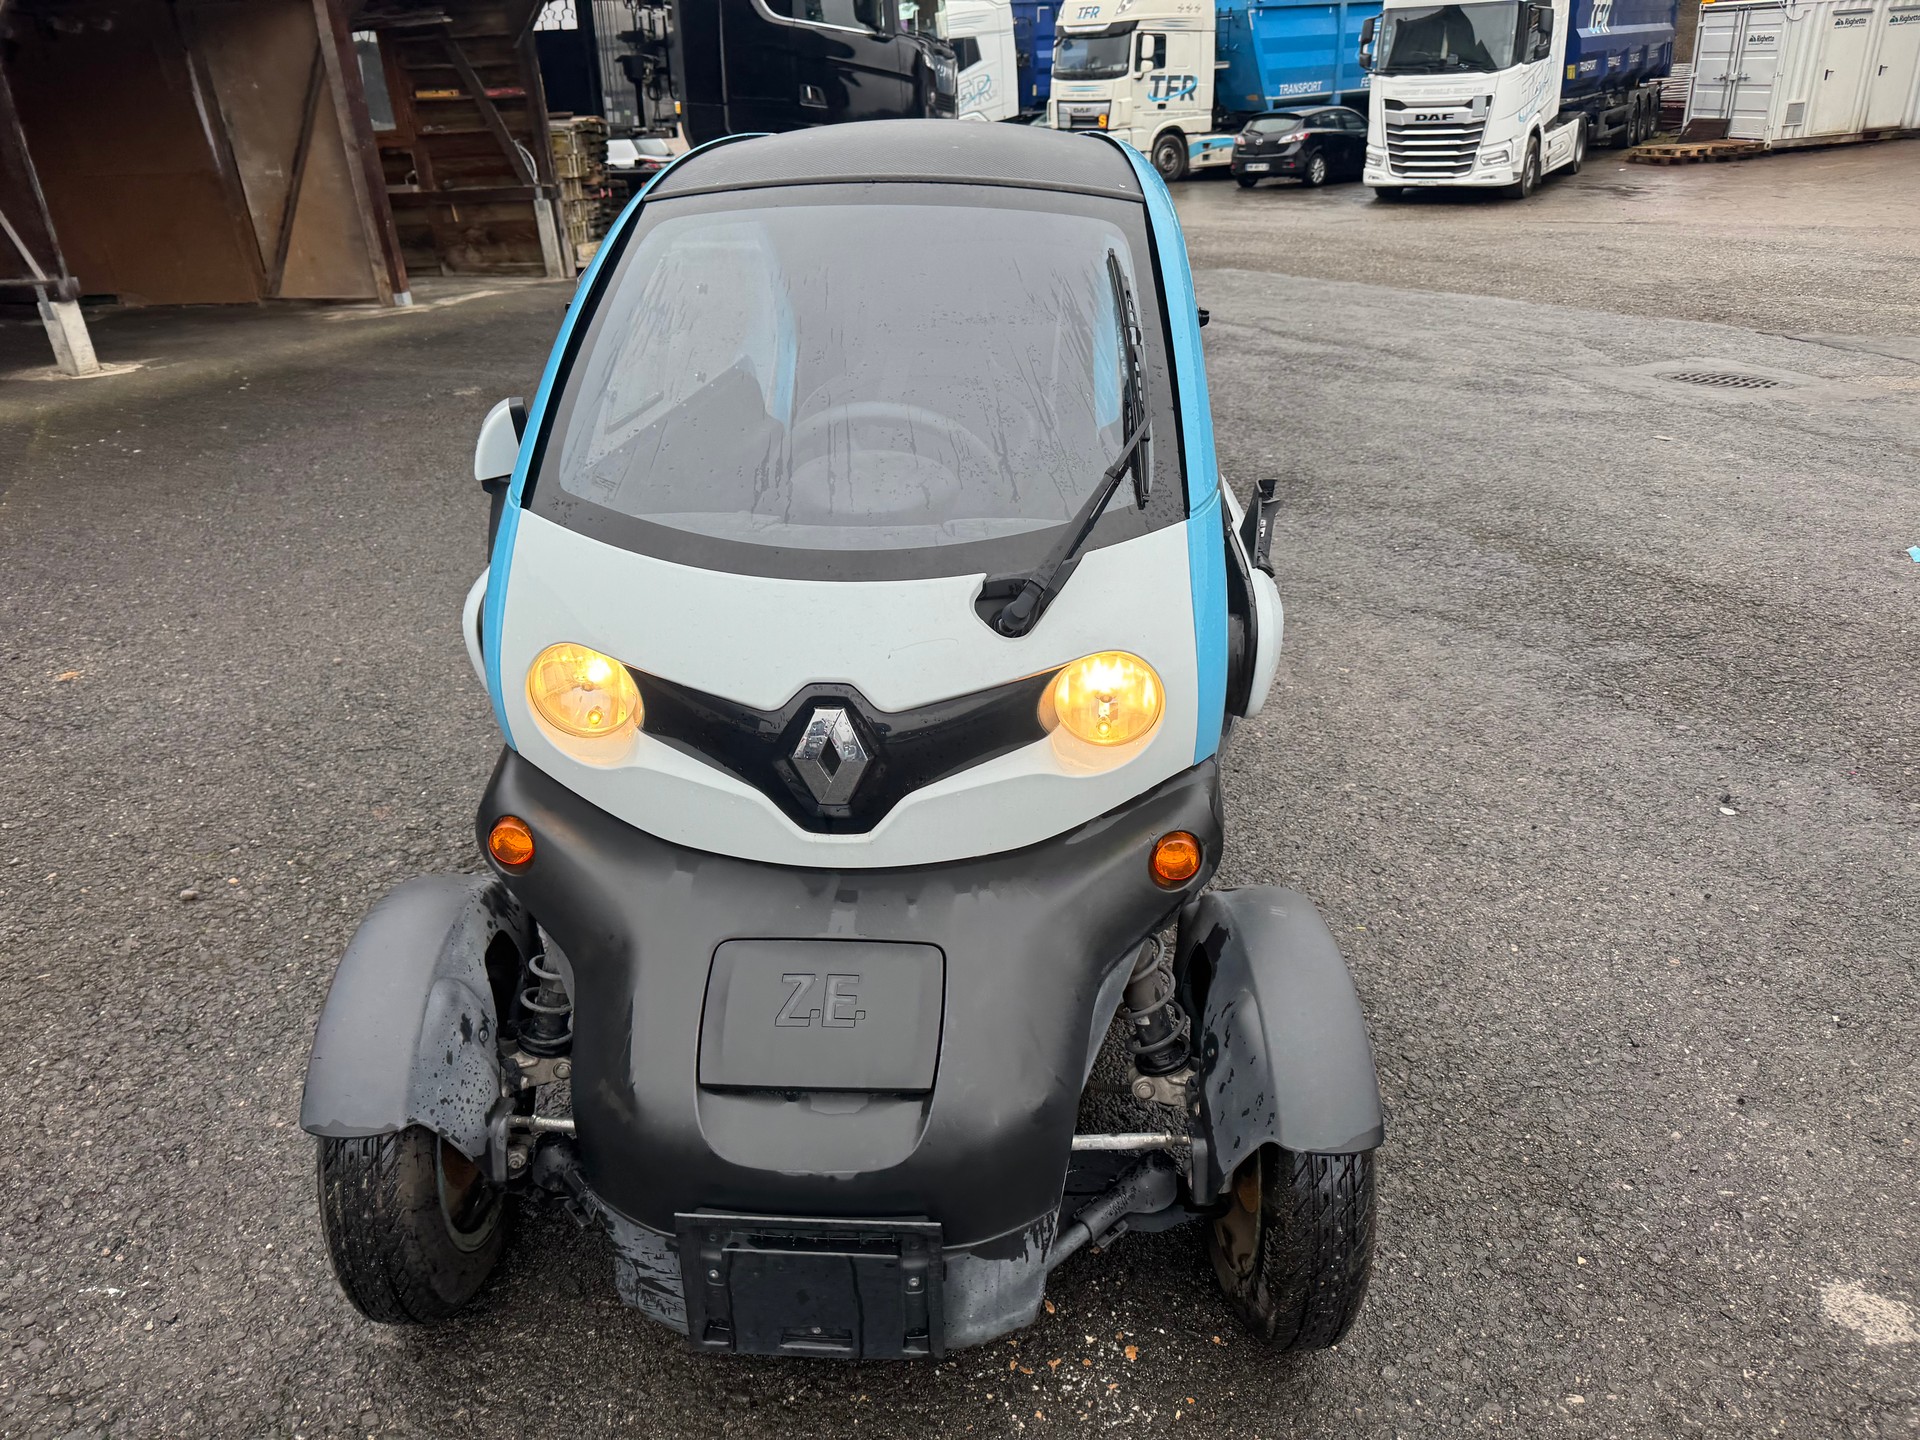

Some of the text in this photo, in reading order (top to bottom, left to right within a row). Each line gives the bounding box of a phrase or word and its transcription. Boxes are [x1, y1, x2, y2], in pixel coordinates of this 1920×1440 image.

[1077, 6, 1101, 19] TFR
[1844, 17, 1867, 27] Righetto
[1756, 34, 1775, 44] Righetto
[1147, 75, 1198, 102] TFR
[1279, 81, 1322, 95] TRANSPORT
[1414, 113, 1455, 121] DAF
